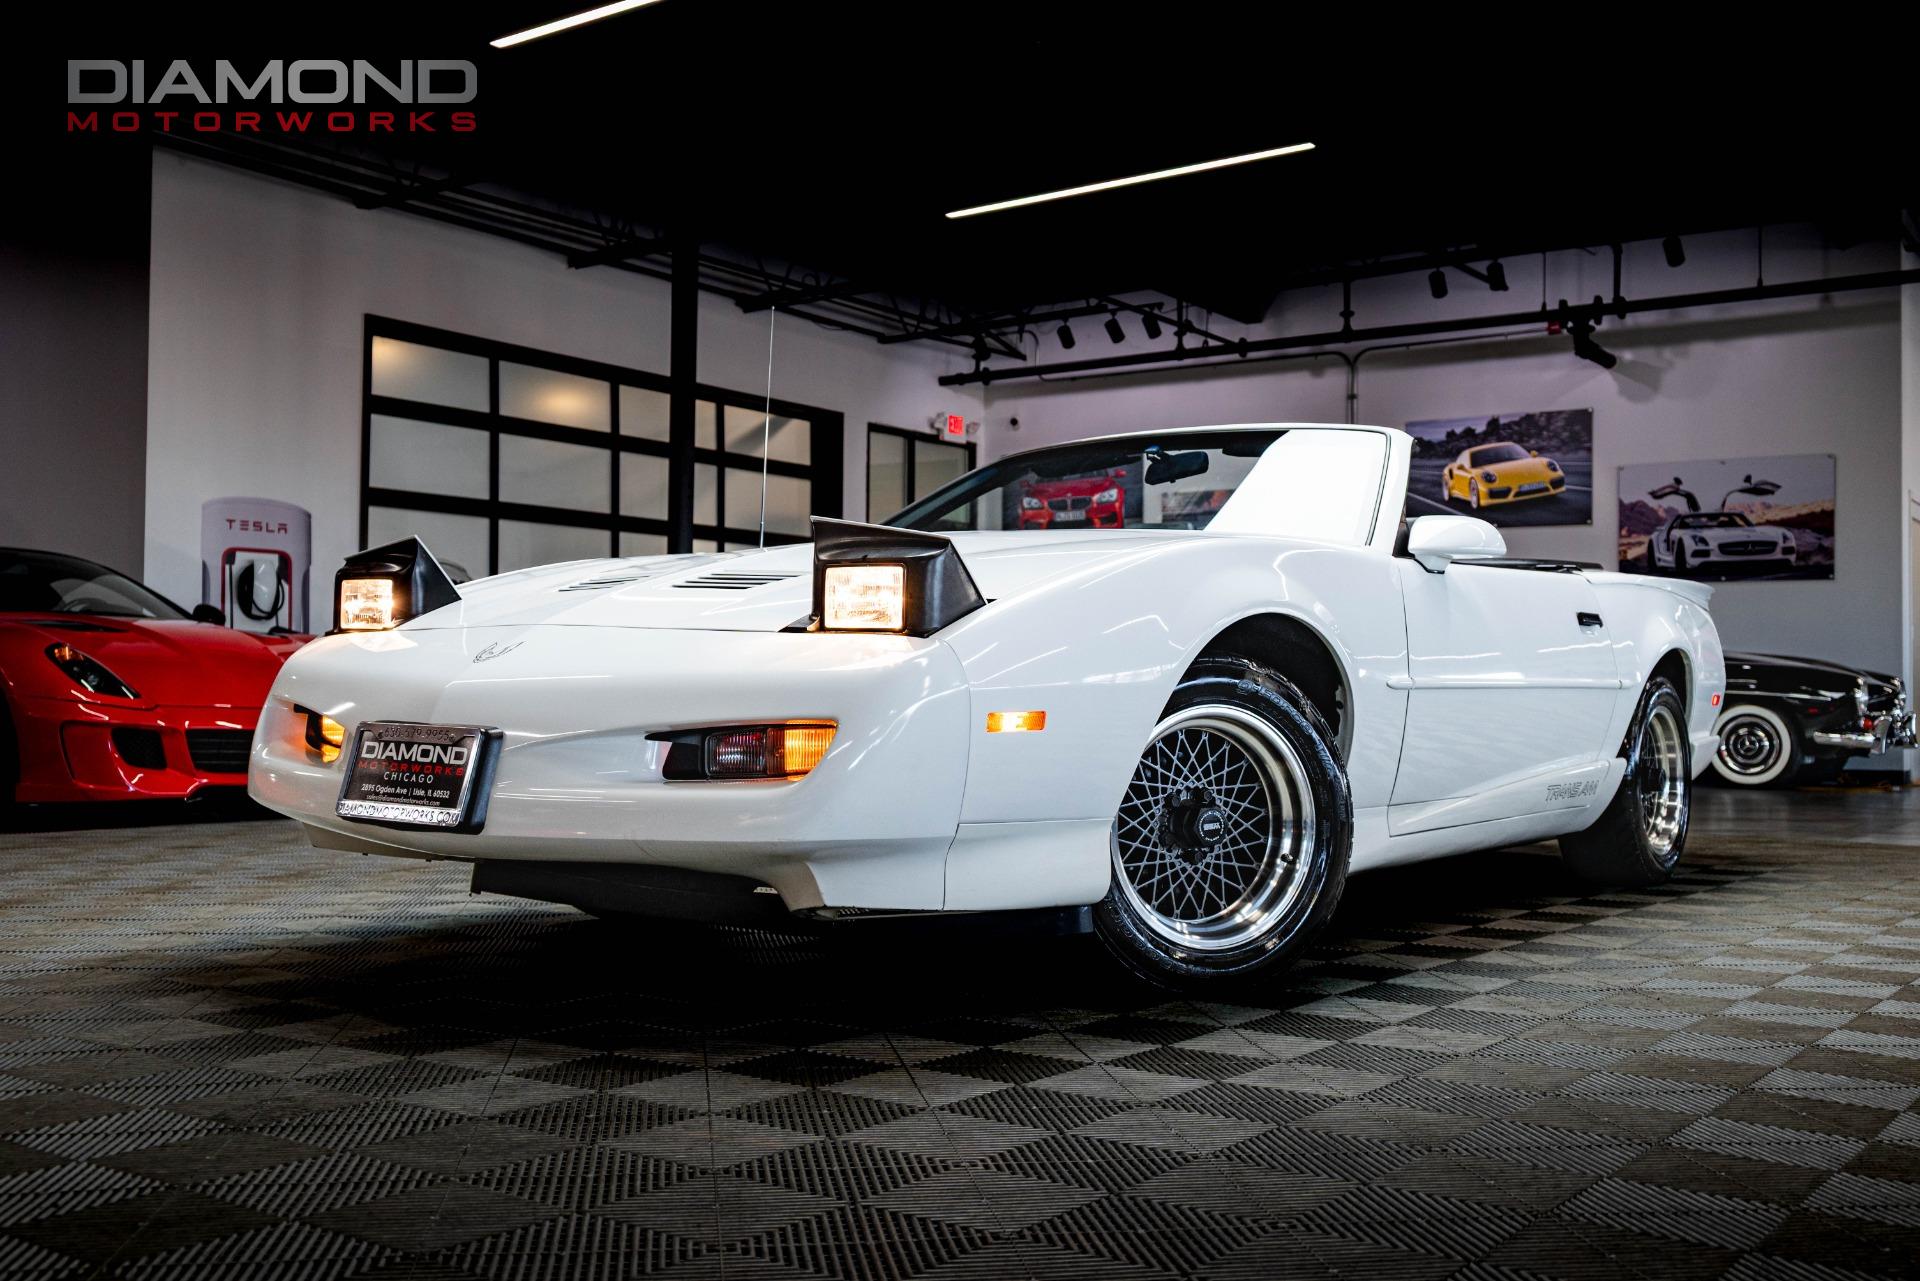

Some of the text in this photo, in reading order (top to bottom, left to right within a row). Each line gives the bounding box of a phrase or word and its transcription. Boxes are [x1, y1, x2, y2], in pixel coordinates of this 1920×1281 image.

[225, 518, 288, 535] TESLA
[360, 741, 468, 765] DIAMOND
[357, 760, 465, 777] MOTORWORKS
[383, 772, 434, 784] CHICAGO
[360, 783, 375, 792] 2895
[375, 785, 395, 794] Ogden
[395, 786, 408, 795] Ave
[432, 790, 450, 799] 60532
